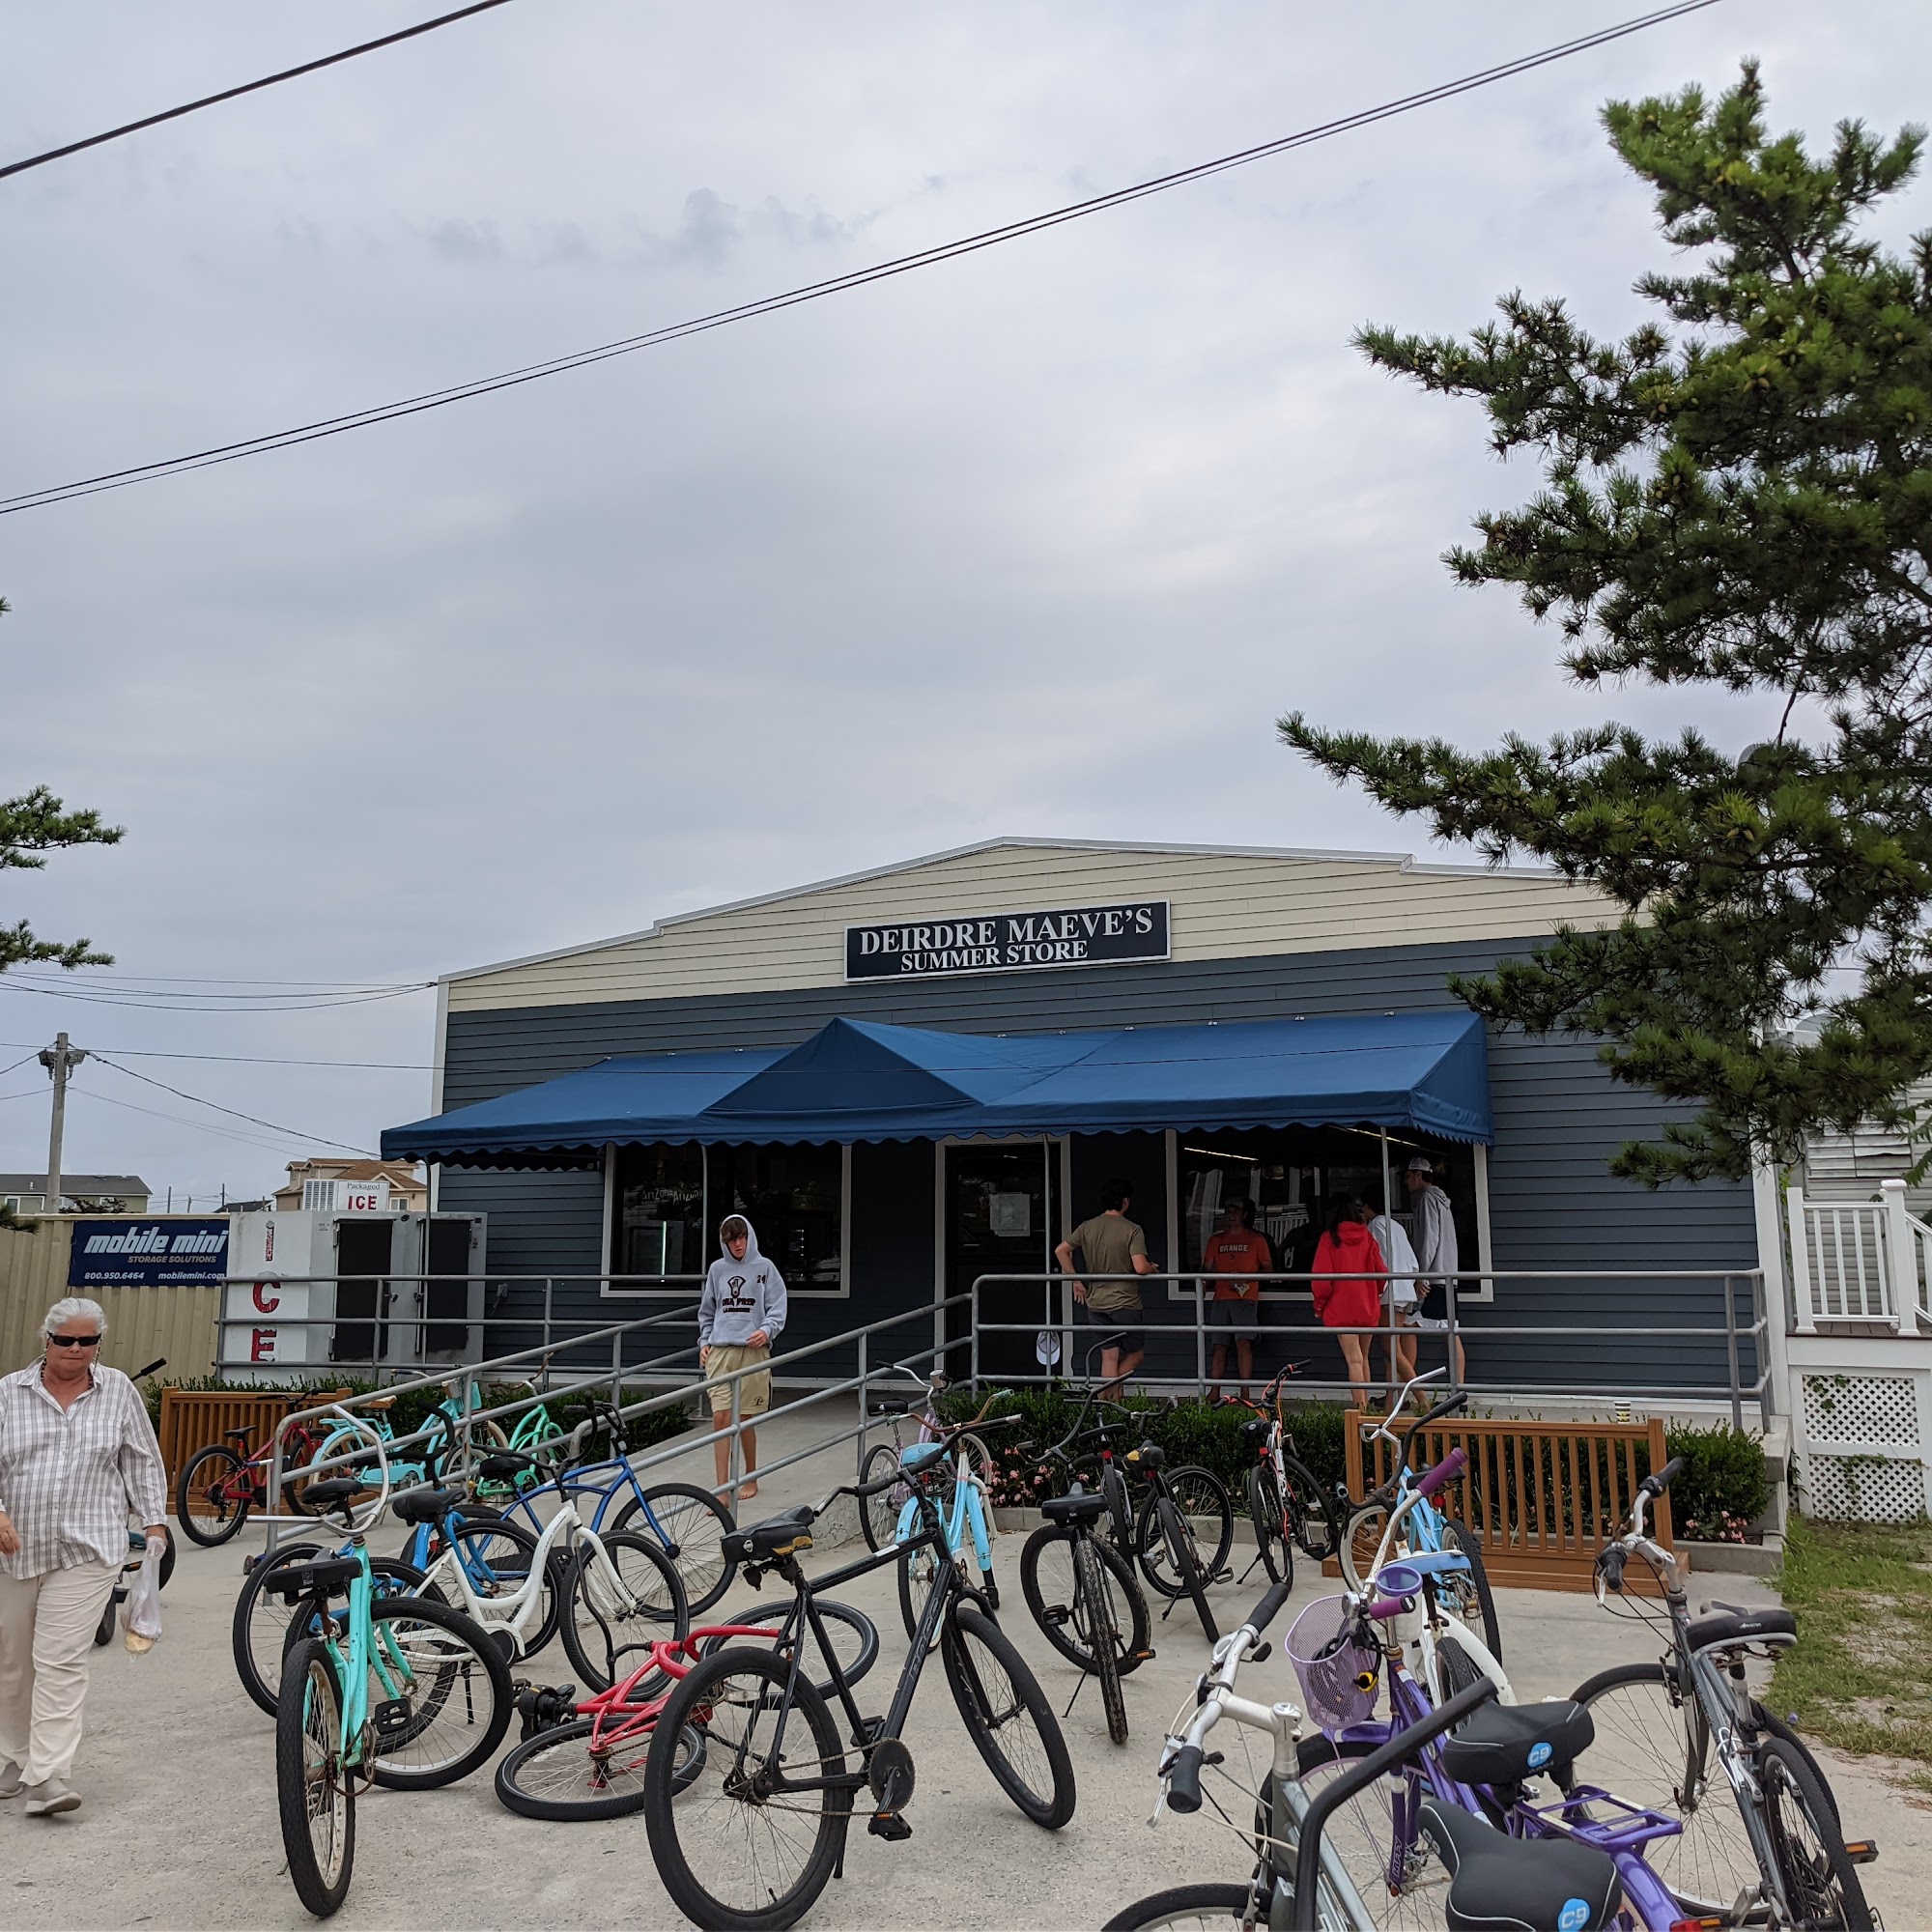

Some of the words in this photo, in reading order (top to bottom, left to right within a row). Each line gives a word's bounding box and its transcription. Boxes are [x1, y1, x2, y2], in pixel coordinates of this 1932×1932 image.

[860, 921, 997, 954] DEIRDRE
[1007, 907, 1153, 944] MAEVE'S
[900, 946, 1001, 972] SUMMER
[1006, 940, 1089, 964] STORE
[348, 1195, 378, 1210] ICE
[83, 1226, 170, 1254] mobile
[170, 1230, 230, 1254] mini
[1219, 1244, 1249, 1253] ORANGE
[128, 1255, 167, 1264] STORAGE
[168, 1255, 217, 1264] SOLUTIONS
[84, 1271, 145, 1280] 800.950.6464
[157, 1271, 225, 1280] mobilemini.com
[1529, 1746, 1549, 1764] C9
[1391, 1833, 1404, 1879] HUFFY
[1561, 1906, 1587, 1929] C9
